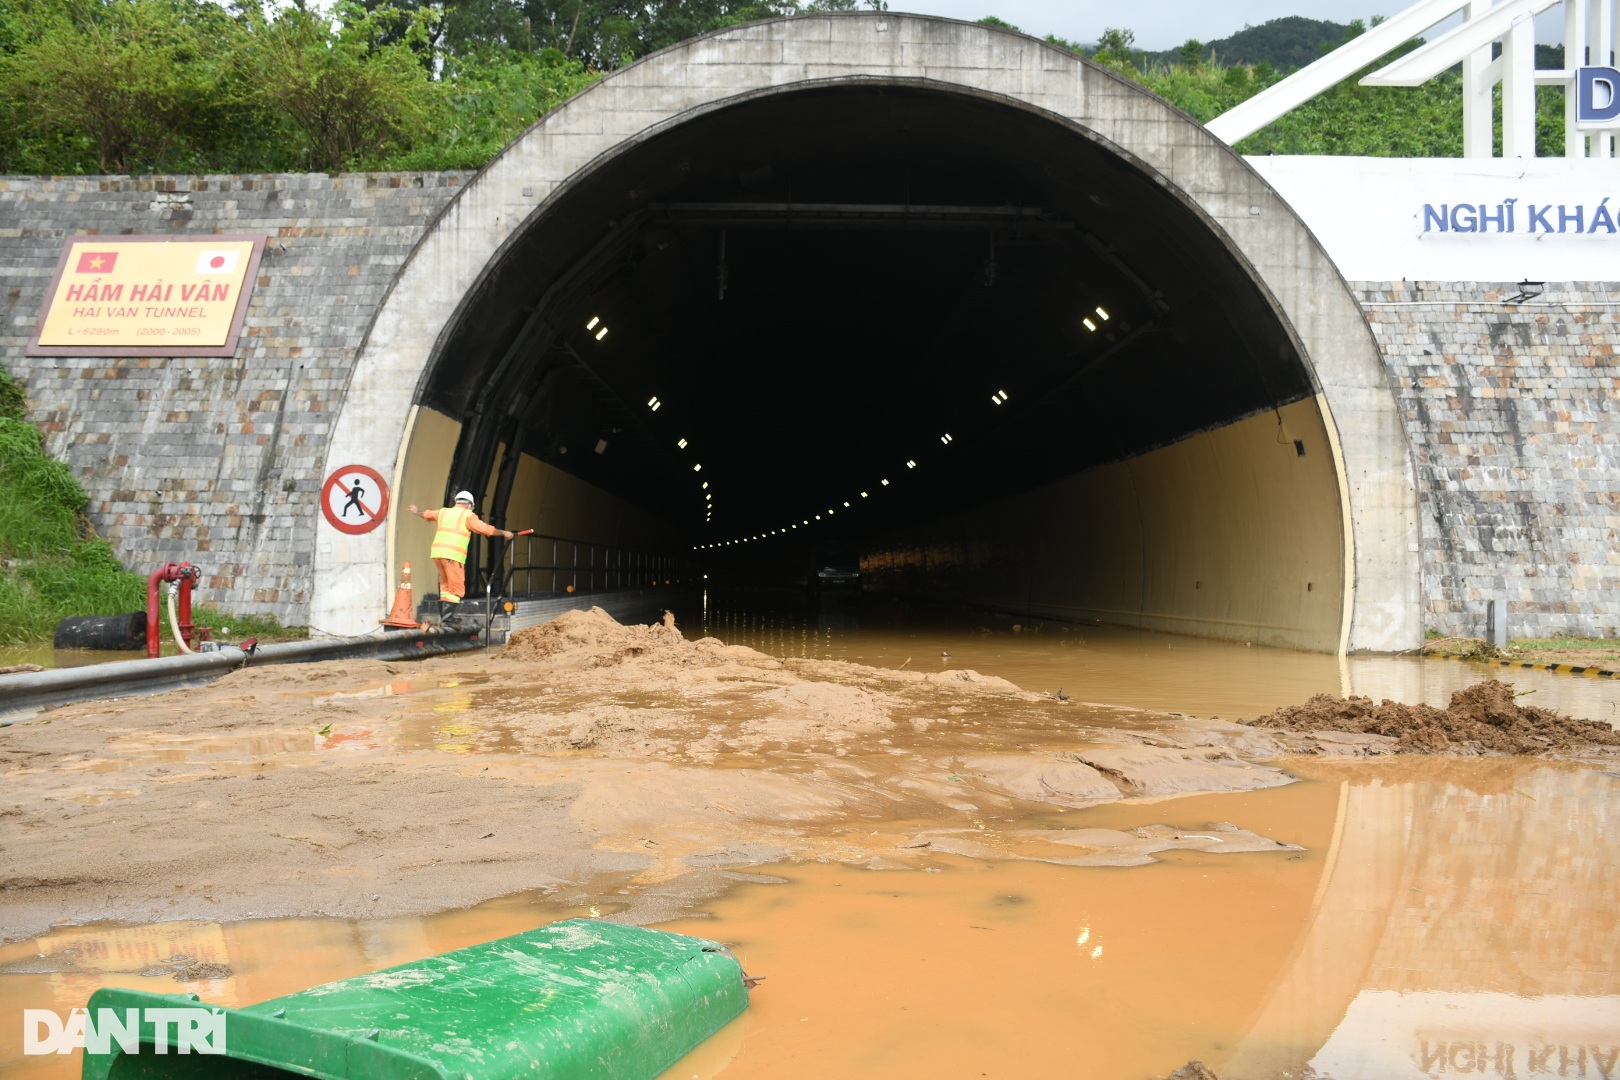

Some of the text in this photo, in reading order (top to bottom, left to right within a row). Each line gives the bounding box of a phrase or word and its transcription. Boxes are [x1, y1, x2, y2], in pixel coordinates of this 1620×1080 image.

[1423, 196, 1620, 234] NGHĨ KHÁ
[65, 278, 230, 302] HẦM HẢI VÂN
[72, 307, 207, 318] HAI VAN TUNNEL
